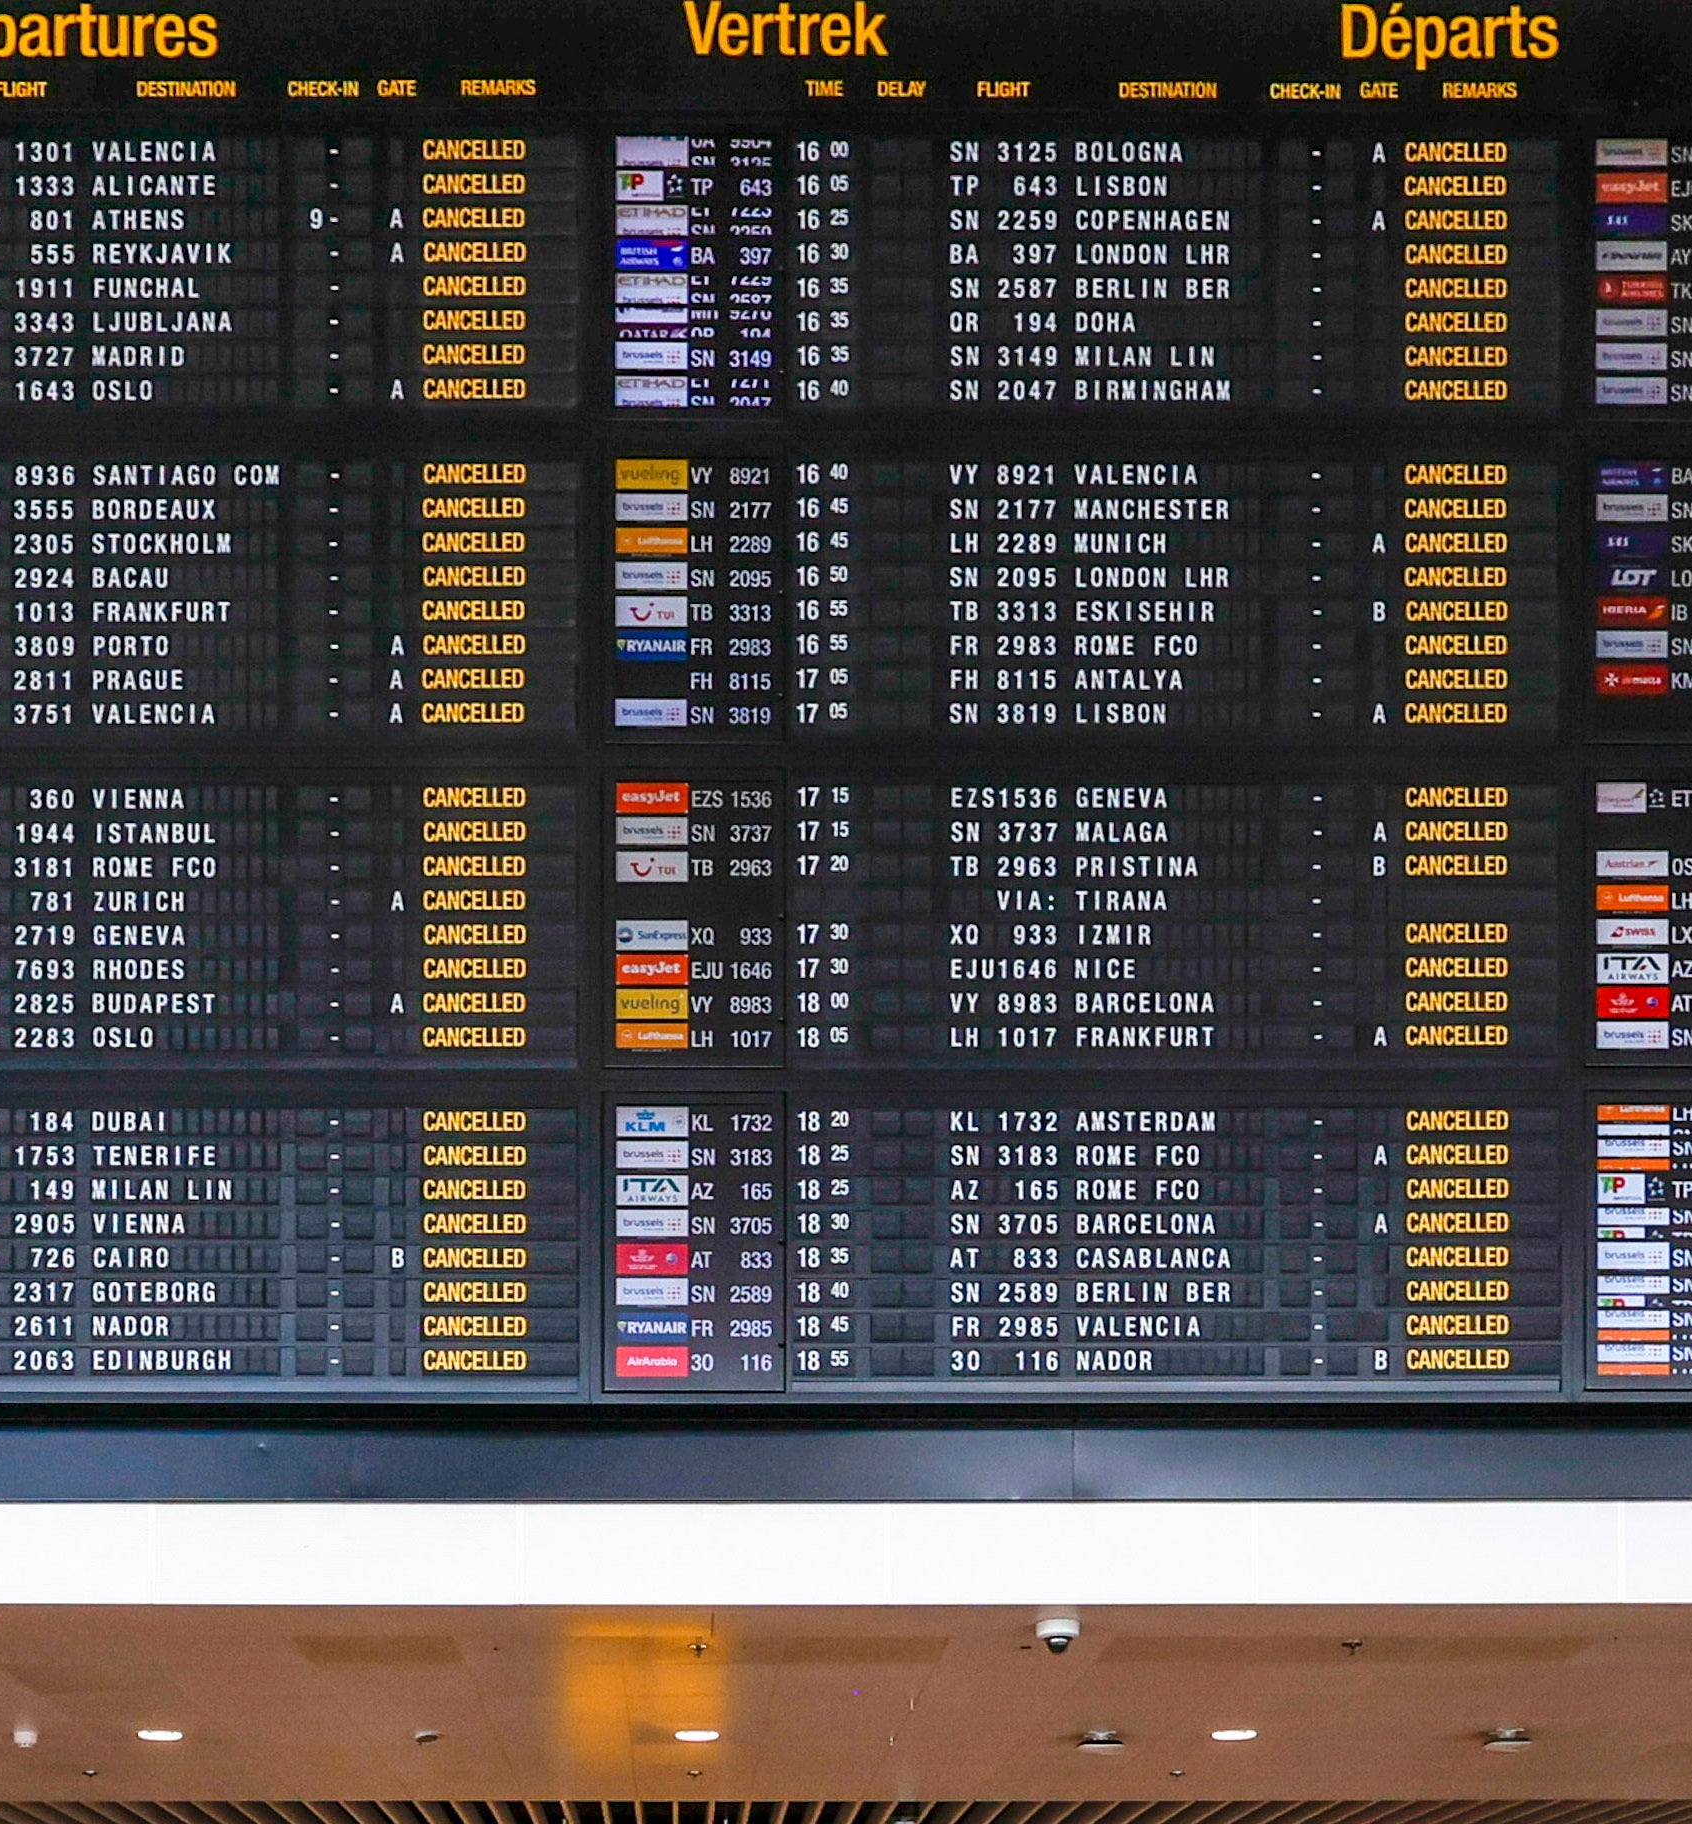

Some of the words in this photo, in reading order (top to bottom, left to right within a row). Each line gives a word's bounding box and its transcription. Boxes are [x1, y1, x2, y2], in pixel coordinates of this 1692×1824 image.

[684, 0, 888, 56] Vertrek
[1342, 3, 1559, 70] Départs
[137, 81, 236, 97] DESTINATION
[288, 81, 359, 97] CHECK-IN
[377, 80, 416, 97] GATE
[461, 79, 536, 95] REMARKS
[806, 80, 843, 96] TIME
[878, 81, 926, 97] DELAY
[977, 81, 1030, 97] FLIGHT
[1119, 82, 1217, 98] DESTINATION
[1270, 83, 1341, 99] CHECK-IN
[1360, 82, 1398, 98] GATE
[1443, 82, 1517, 98] REMARKS
[15, 141, 75, 163] 1301
[92, 140, 216, 163] VALENCIA
[422, 138, 527, 161] CANCELLED
[949, 140, 979, 163] SN
[997, 140, 1057, 163] 3125
[1074, 140, 1183, 163] BOLOGNA
[1404, 141, 1508, 163] CANCELLED
[949, 209, 980, 231] SN
[997, 209, 1057, 231] 2259
[1075, 209, 1230, 231] COPENHAGEN
[1404, 209, 1508, 231] CANCELLED
[30, 243, 75, 265] 555
[92, 242, 232, 265] REYKJAVIK
[423, 241, 528, 263] CANCELLED
[15, 464, 75, 486] 8936
[92, 464, 216, 486] SANTIAGO
[233, 464, 280, 486] COM
[423, 463, 527, 485] CANCELLED
[950, 498, 979, 520] SN
[996, 498, 1057, 520] 2177
[1073, 498, 1229, 520] MANCHESTER
[1404, 498, 1507, 520] CANCELLED
[1611, 570, 1657, 586] LOT
[627, 639, 686, 652] RYANAIR
[950, 635, 978, 656] FR
[996, 635, 1057, 656] 2983
[1074, 634, 1135, 656] ROME
[1154, 634, 1198, 657] FCO
[1404, 634, 1509, 656] CANCELLED
[621, 790, 681, 803] easyJet
[15, 822, 75, 844] 1944
[96, 822, 216, 844] ISTANBUL
[423, 820, 527, 843] CANCELLED
[950, 855, 979, 877] TB
[997, 855, 1057, 878] 2963
[1075, 855, 1198, 878] PRISTINA
[1404, 854, 1508, 876] CANCELLED
[14, 993, 74, 1014] 2825
[92, 992, 216, 1014] BUDAPEST
[422, 992, 527, 1013] CANCELLED
[621, 994, 680, 1014] vueling
[949, 992, 979, 1014] VY
[997, 992, 1057, 1014] 8983
[1075, 992, 1215, 1014] BARCELONA
[1405, 991, 1508, 1013] CANCELLED
[625, 1121, 665, 1132] KLM
[950, 1110, 979, 1132] KL
[998, 1111, 1058, 1132] 1732
[1075, 1110, 1216, 1132] AMSTERDAM
[1405, 1109, 1509, 1132] CANCELLED
[15, 1145, 75, 1166] 1753
[92, 1145, 216, 1166] TENERIFE
[423, 1145, 527, 1167] CANCELLED
[949, 1247, 980, 1269] AT
[1013, 1247, 1058, 1269] 833
[1076, 1247, 1231, 1269] CASABLANCA
[1406, 1246, 1510, 1268] CANCELLED
